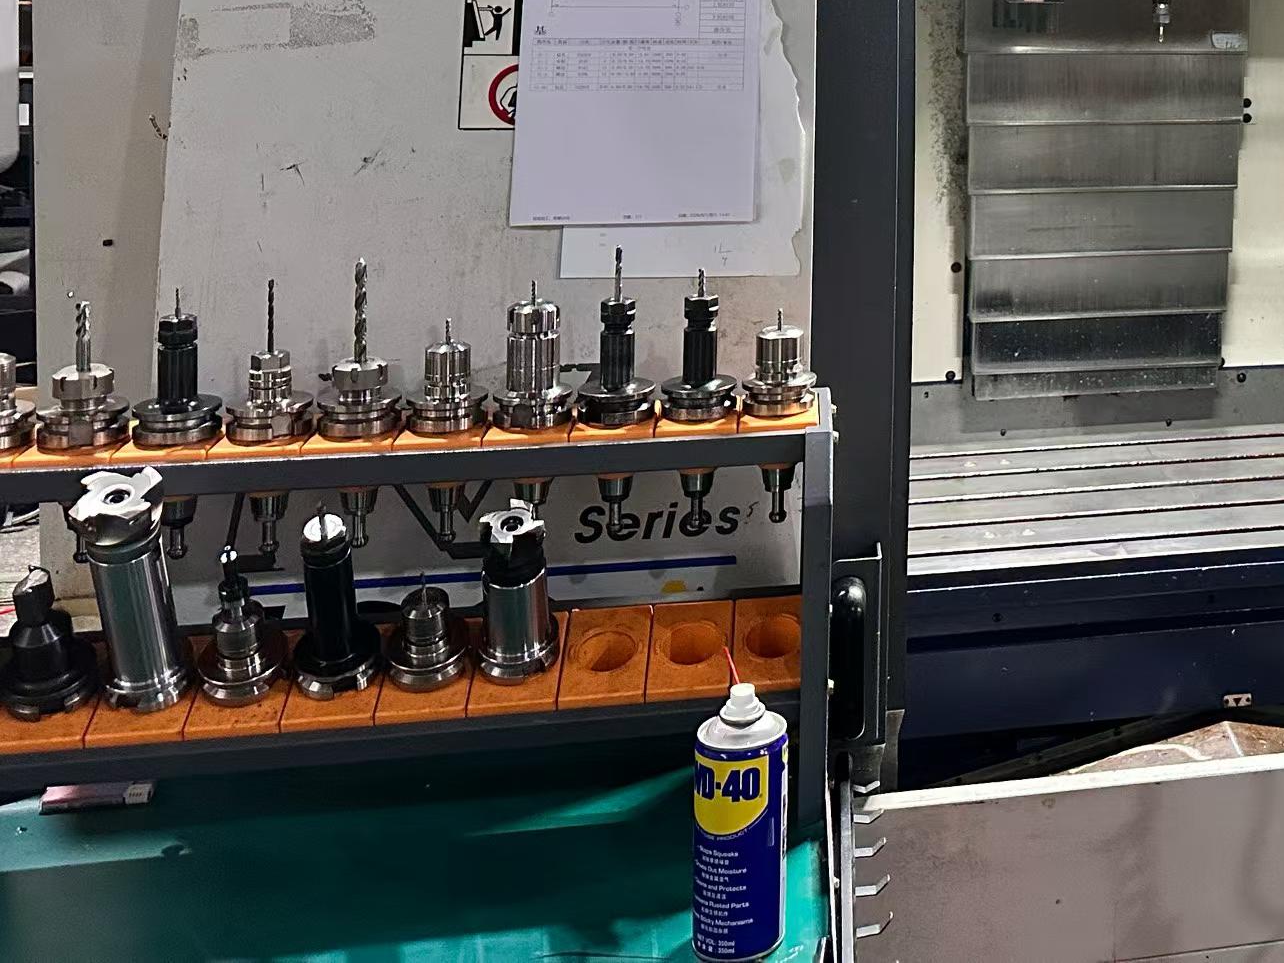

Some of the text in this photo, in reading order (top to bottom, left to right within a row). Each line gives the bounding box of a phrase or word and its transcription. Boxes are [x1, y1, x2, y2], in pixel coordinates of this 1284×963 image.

[574, 502, 742, 545] Series
[718, 866, 747, 875] Moisture
[718, 885, 747, 893] Protects
[730, 901, 750, 909] Parts
